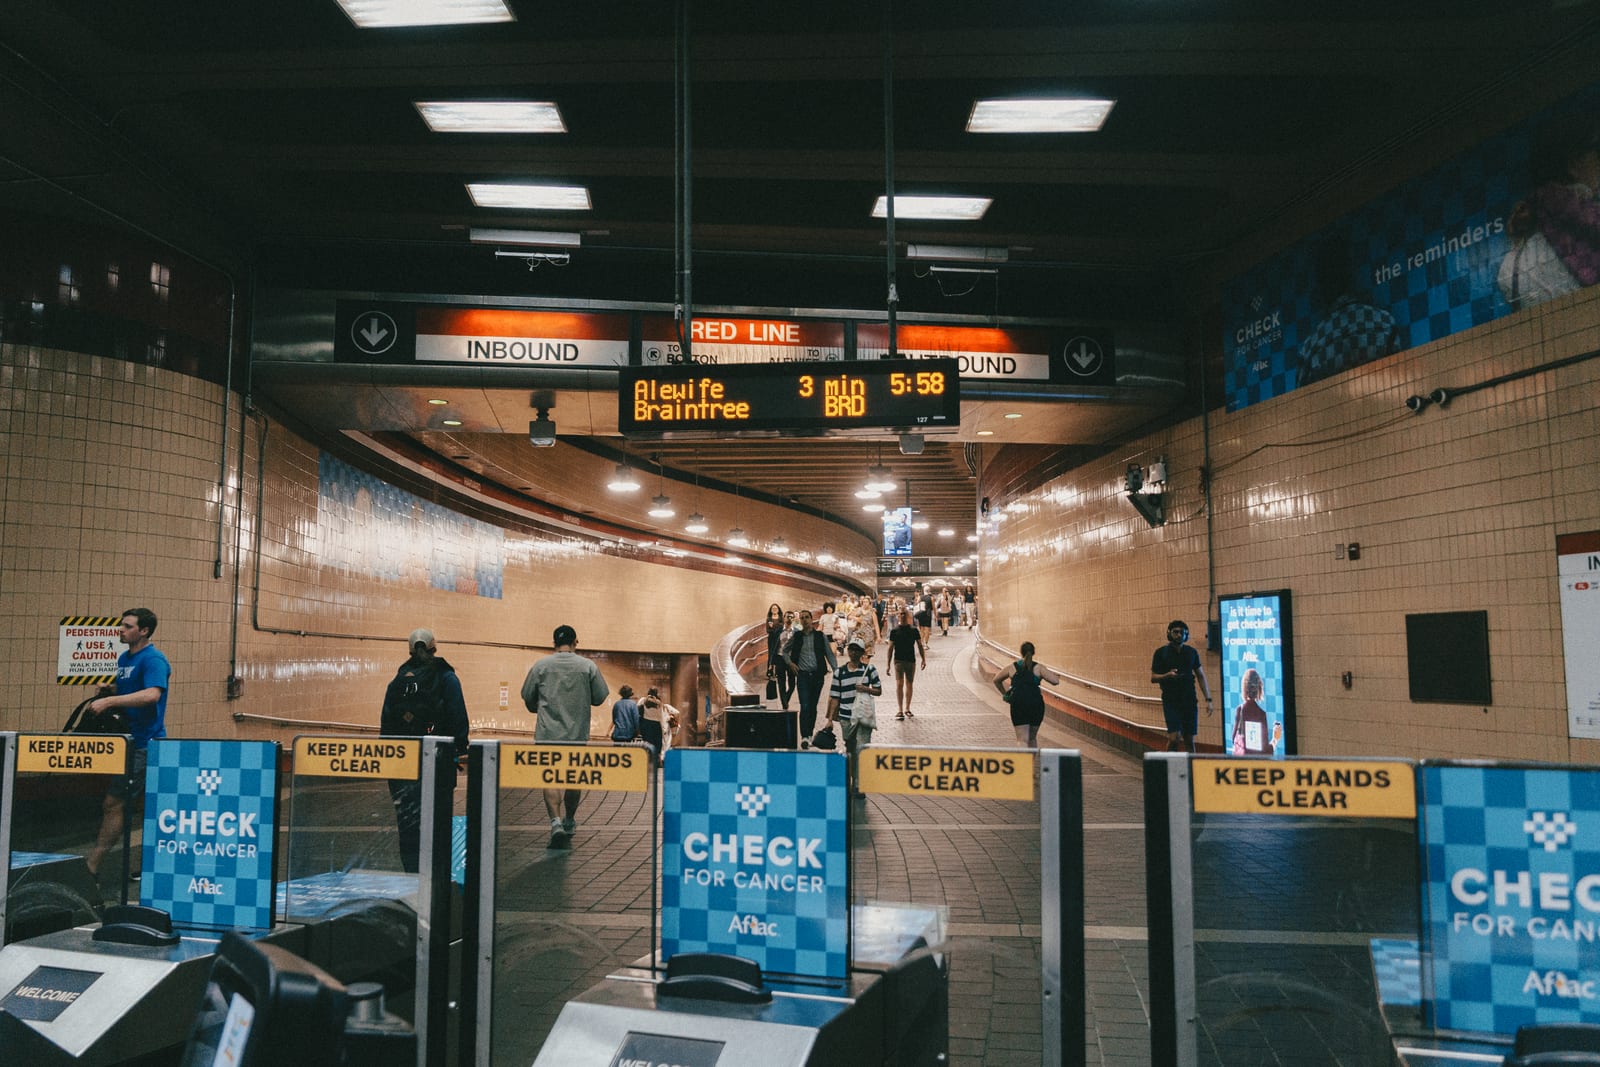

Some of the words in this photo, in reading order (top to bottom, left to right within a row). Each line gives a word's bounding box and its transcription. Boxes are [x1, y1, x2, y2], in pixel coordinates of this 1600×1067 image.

[1375, 264, 1402, 285] the
[1407, 216, 1504, 271] reminders
[691, 320, 737, 340] RED
[750, 323, 800, 343] LINE
[1236, 311, 1281, 344] CHECK
[467, 340, 579, 362] INBOUND
[667, 344, 680, 352] TO
[807, 349, 819, 357] TO
[667, 353, 718, 365] BOTON
[634, 378, 724, 400] Alewife
[799, 375, 814, 397] 3
[824, 374, 866, 395] min
[890, 372, 945, 395] 5:58
[634, 399, 750, 420] Braintree
[824, 395, 866, 417] BRD
[1230, 606, 1237, 617] is
[1238, 606, 1244, 617] it
[1245, 605, 1262, 617] time
[1263, 606, 1272, 616] to
[65, 628, 120, 637] PEDESTRIAN
[72, 651, 117, 660] CAUTION
[85, 641, 105, 650] USE
[29, 740, 63, 754] KEEP
[68, 741, 115, 754] HANDS
[307, 743, 349, 757] KEEP
[354, 744, 406, 759] HANDS
[49, 755, 93, 769] CLEAR
[330, 758, 381, 773] CLEAR
[514, 750, 562, 767] KEEP
[568, 752, 633, 768] HANDS
[875, 755, 932, 772] KEEP
[938, 756, 1015, 775] HANDS
[542, 768, 602, 784] CLEAR
[908, 773, 980, 792] CLEAR
[1214, 767, 1286, 786] KEEP
[1295, 768, 1391, 788] HANDS
[1257, 789, 1348, 809] CLEAR
[158, 808, 257, 838] CHECK
[157, 839, 189, 856] FOR
[192, 841, 257, 859] CANCER
[683, 832, 823, 870] CHECK
[187, 877, 224, 896] Aflac
[683, 868, 727, 887] FOR
[733, 871, 824, 894] CANCER
[727, 914, 778, 937] Aflac
[1453, 912, 1516, 937] FOR
[1526, 917, 1600, 943] CAN
[15, 985, 81, 1003] WELCOME
[1522, 969, 1596, 1000] Aflac
